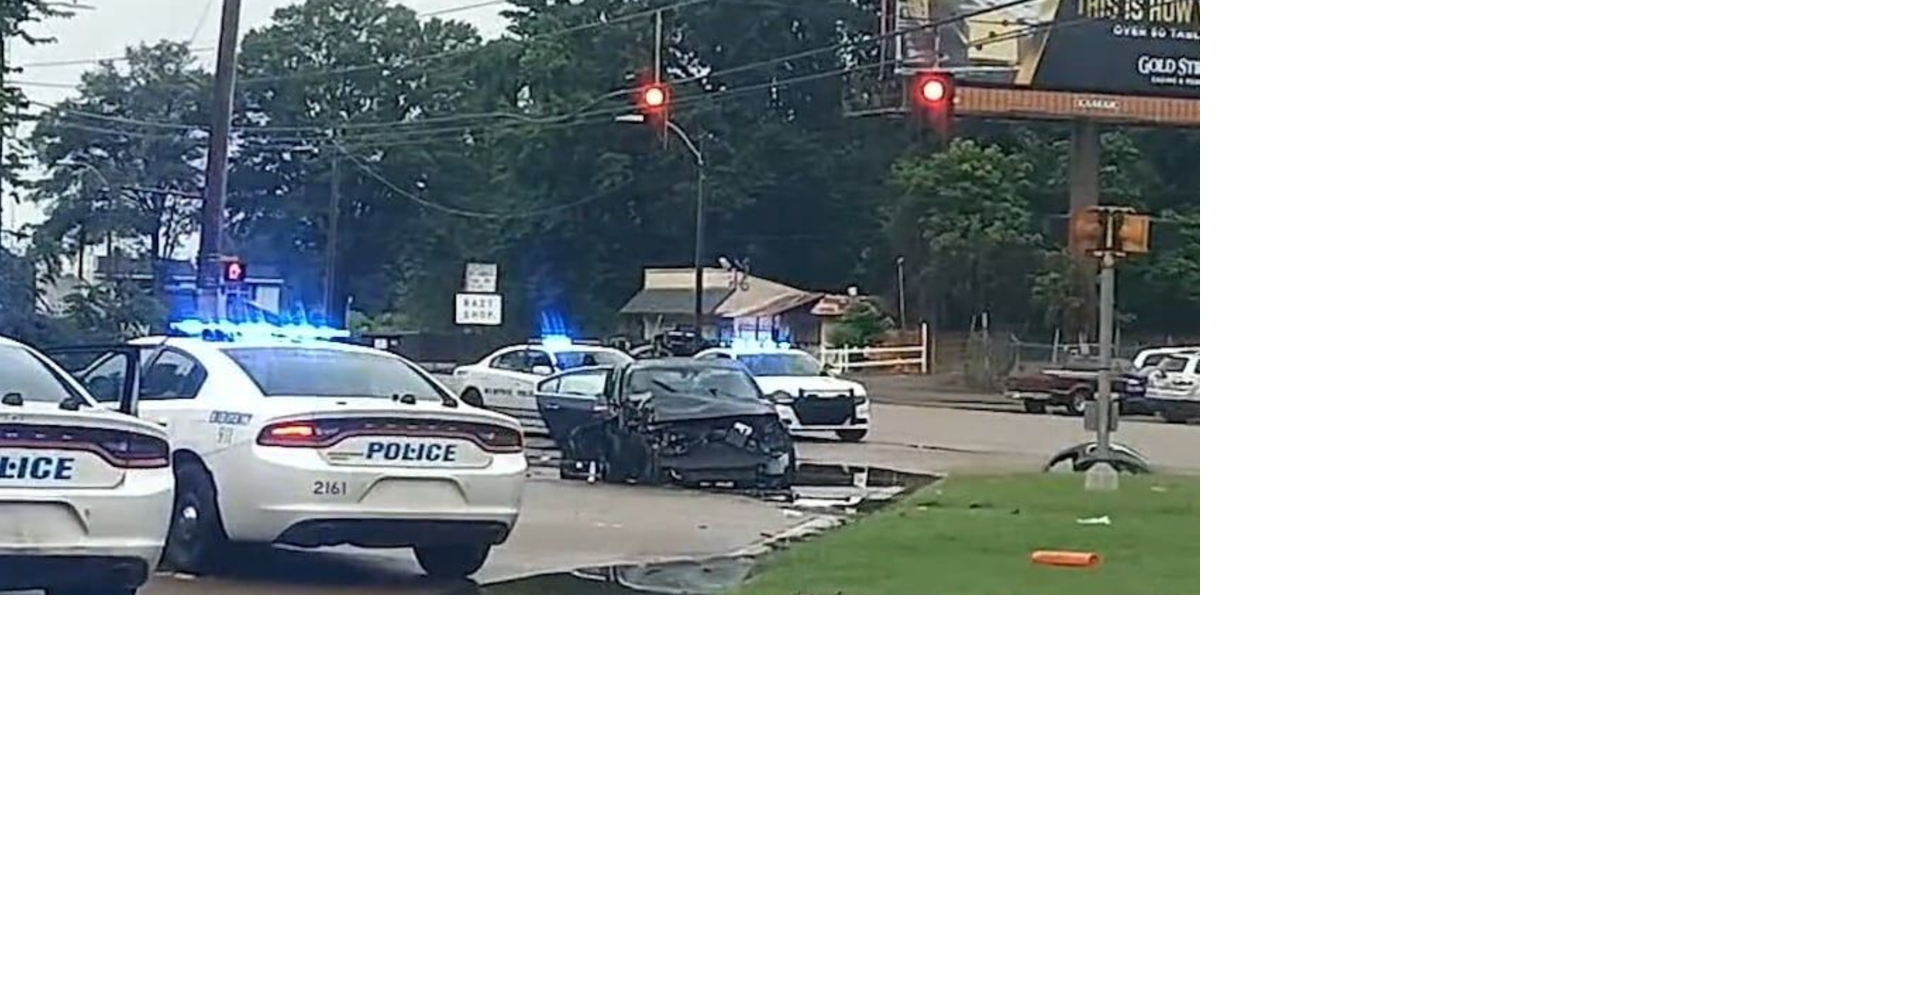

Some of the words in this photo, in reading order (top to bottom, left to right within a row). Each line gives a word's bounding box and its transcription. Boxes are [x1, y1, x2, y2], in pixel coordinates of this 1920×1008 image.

[1124, 0, 1143, 20] IS
[1149, 0, 1194, 23] HOW
[1113, 24, 1147, 37] OVER
[1138, 56, 1176, 74] GOLD
[365, 442, 457, 462] POLICE
[313, 480, 347, 495] 2161
